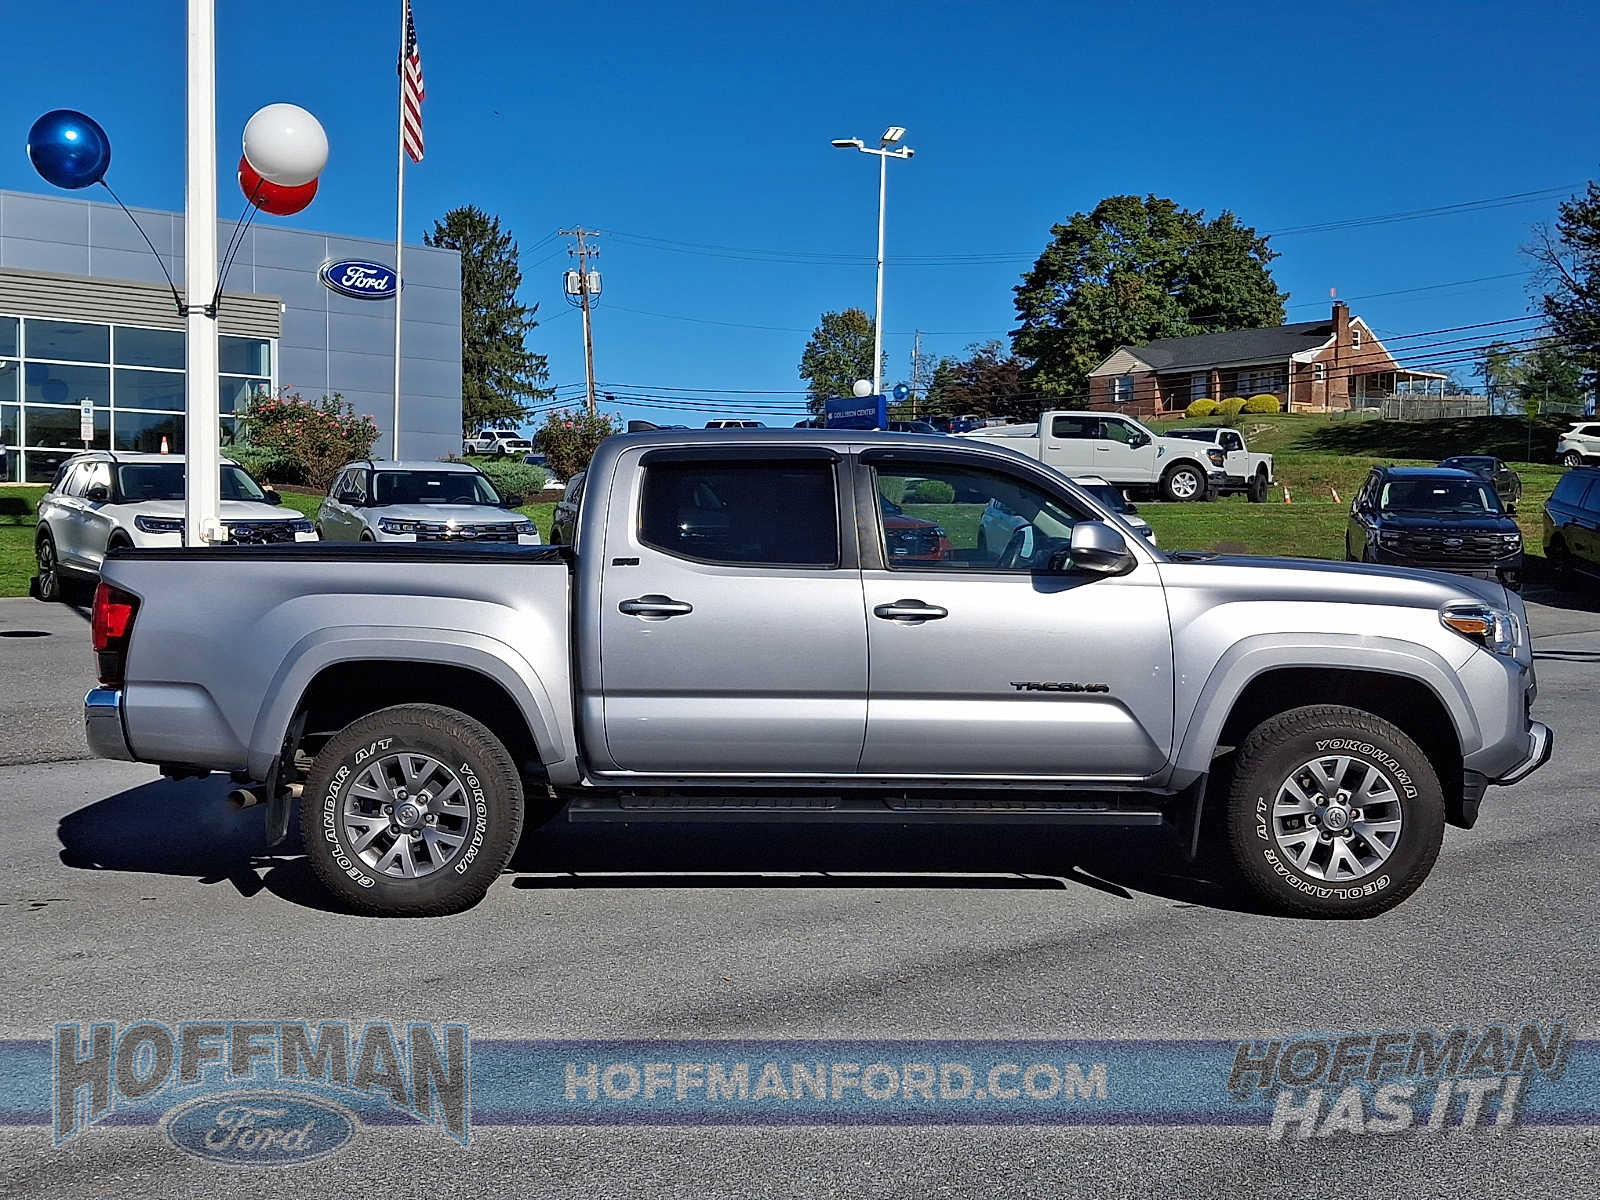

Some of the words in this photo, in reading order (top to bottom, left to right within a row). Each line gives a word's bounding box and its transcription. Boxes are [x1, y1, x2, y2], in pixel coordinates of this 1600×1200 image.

[341, 266, 389, 290] Ford
[1010, 681, 1110, 693] TACOMA
[1315, 738, 1418, 799] YOKOHAMA
[323, 766, 375, 888] GEOLANDAR
[354, 737, 393, 764] A/T
[455, 762, 487, 875] YOKOHAMA
[1256, 796, 1269, 841] A/T
[1264, 848, 1391, 900] GEOLANDAR
